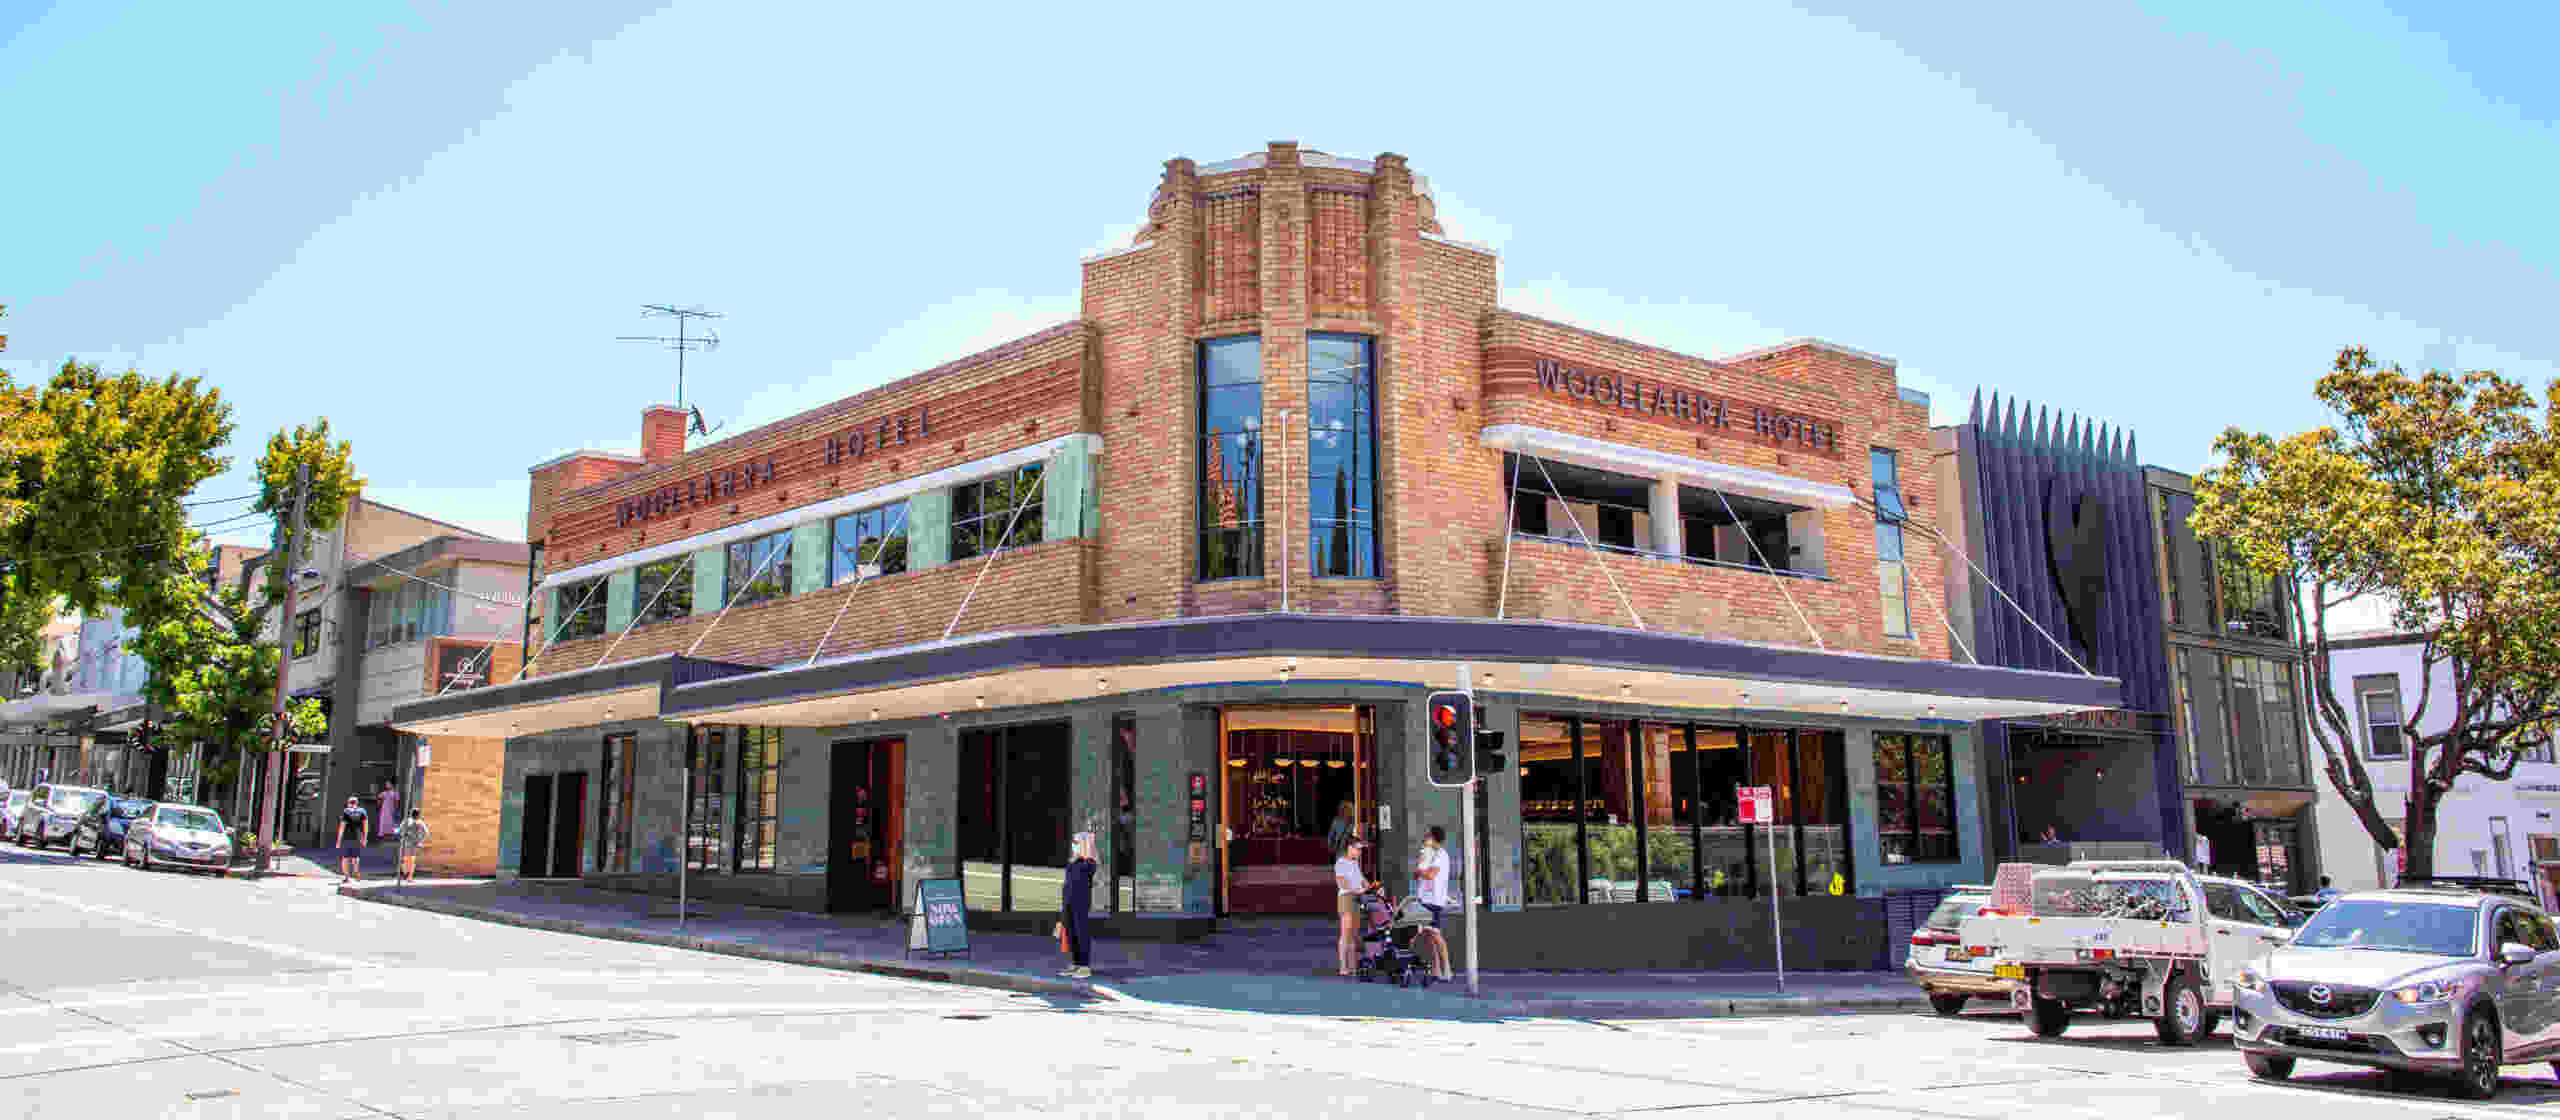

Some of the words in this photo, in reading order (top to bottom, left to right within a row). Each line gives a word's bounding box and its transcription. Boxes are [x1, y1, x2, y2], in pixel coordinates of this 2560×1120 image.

[1536, 359, 1730, 428] WOOLLAHRA
[1754, 406, 1840, 453] HOTEL
[616, 456, 776, 528] WOOLLAHRA
[823, 407, 929, 465] HOTEL
